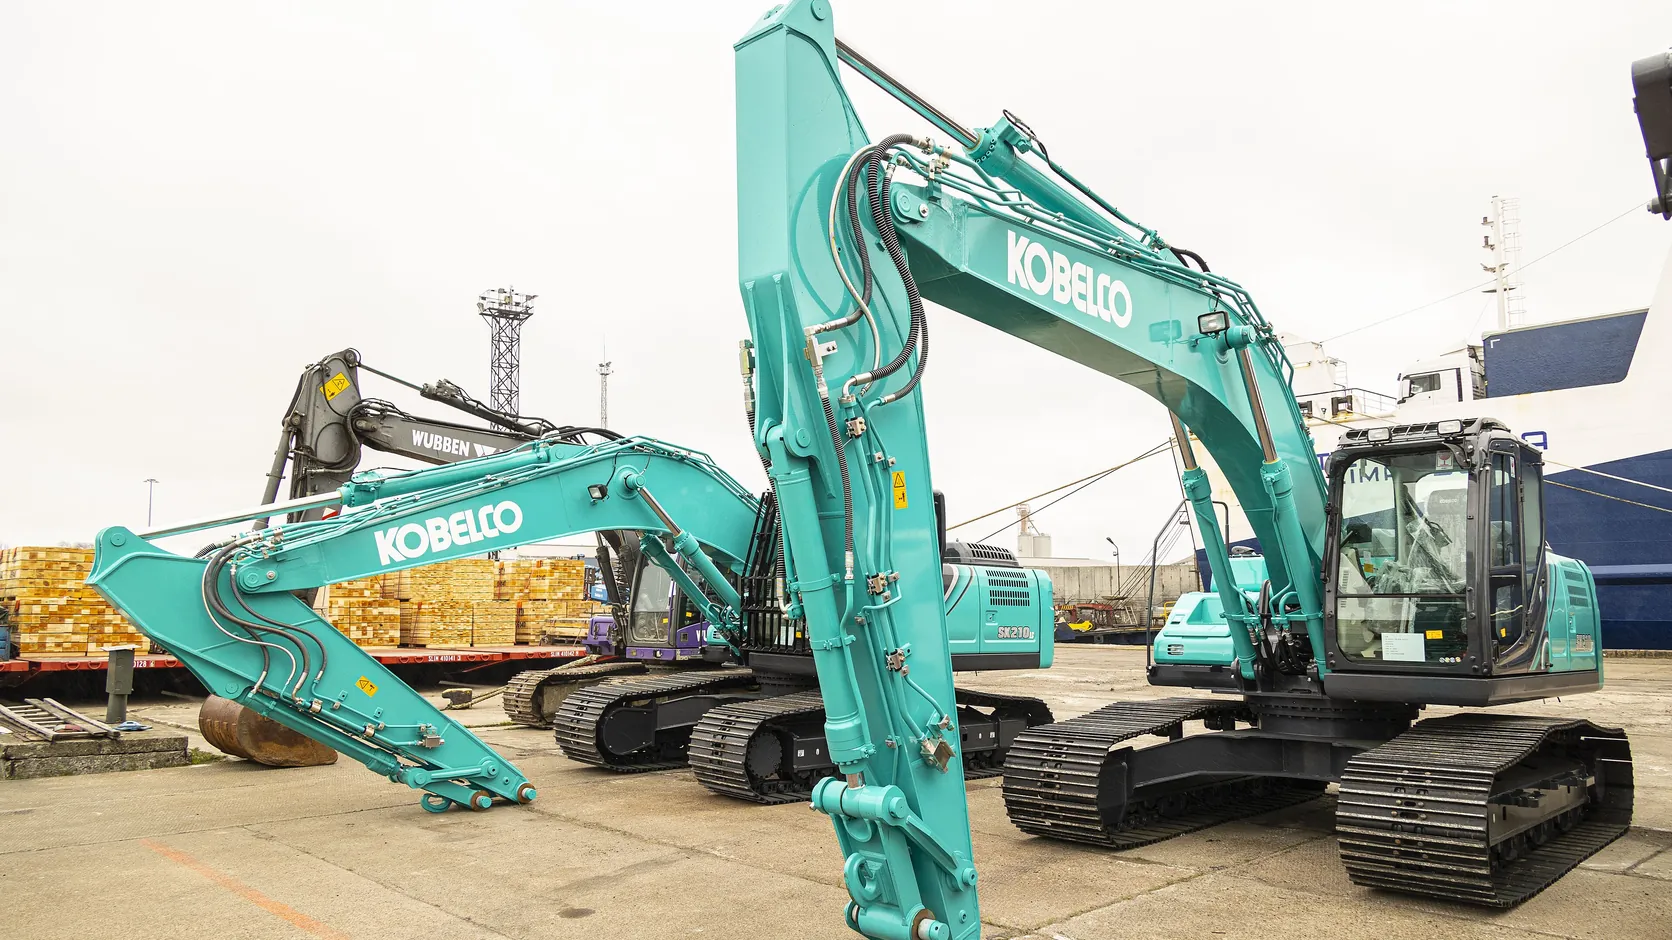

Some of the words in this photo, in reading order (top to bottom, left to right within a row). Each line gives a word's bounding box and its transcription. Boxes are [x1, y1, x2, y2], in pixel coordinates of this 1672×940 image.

[1007, 229, 1133, 329] KOBELCO
[411, 429, 470, 457] WUBBEN
[373, 500, 523, 566] KOBELCO
[997, 626, 1030, 639] SK210
